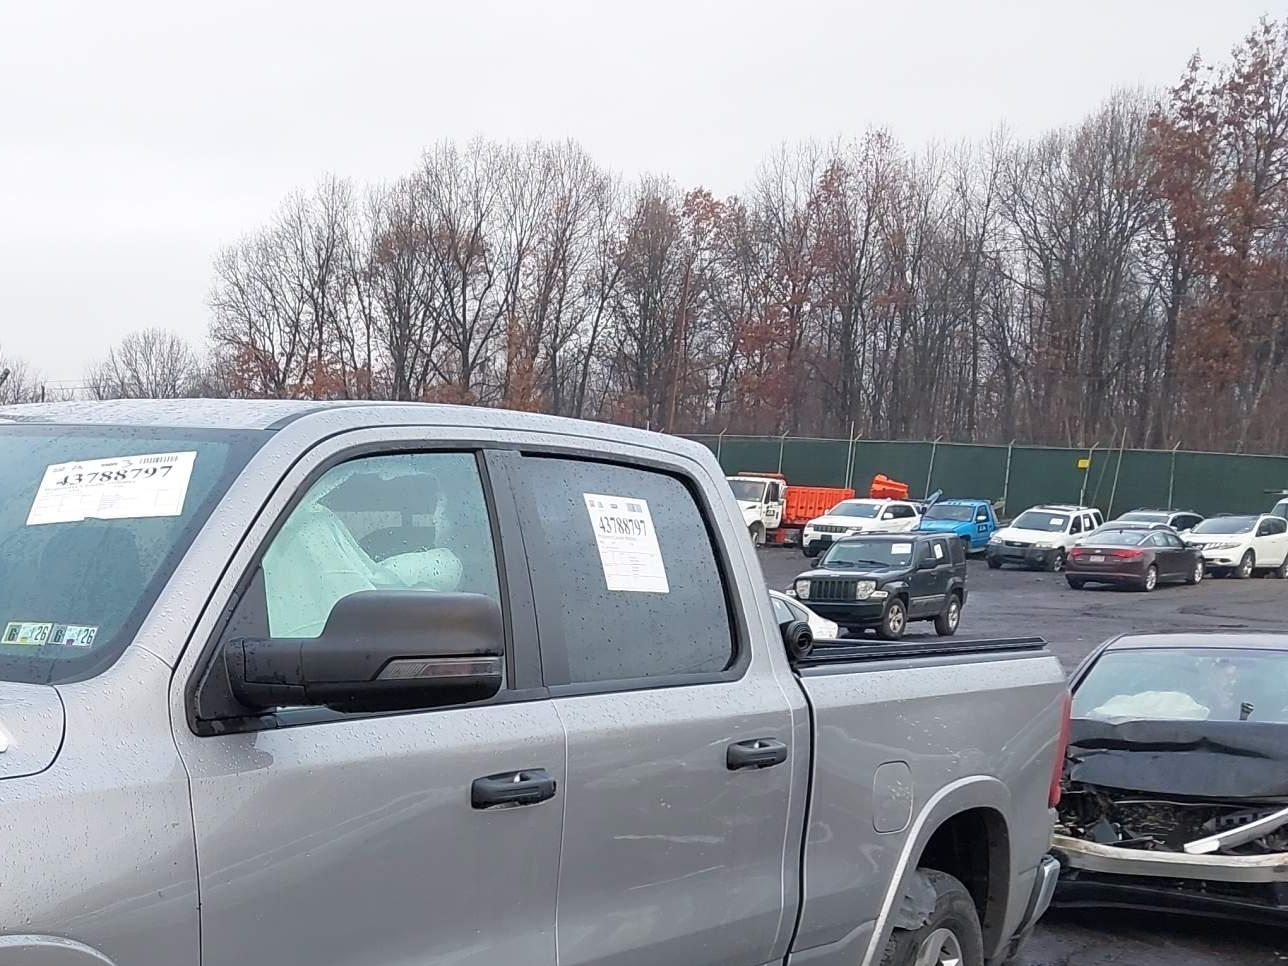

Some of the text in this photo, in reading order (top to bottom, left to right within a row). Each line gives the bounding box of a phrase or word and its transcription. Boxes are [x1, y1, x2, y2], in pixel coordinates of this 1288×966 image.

[56, 465, 173, 486] 43788797
[598, 516, 647, 537] 43788797
[34, 625, 49, 640] 26
[81, 628, 96, 644] 26
